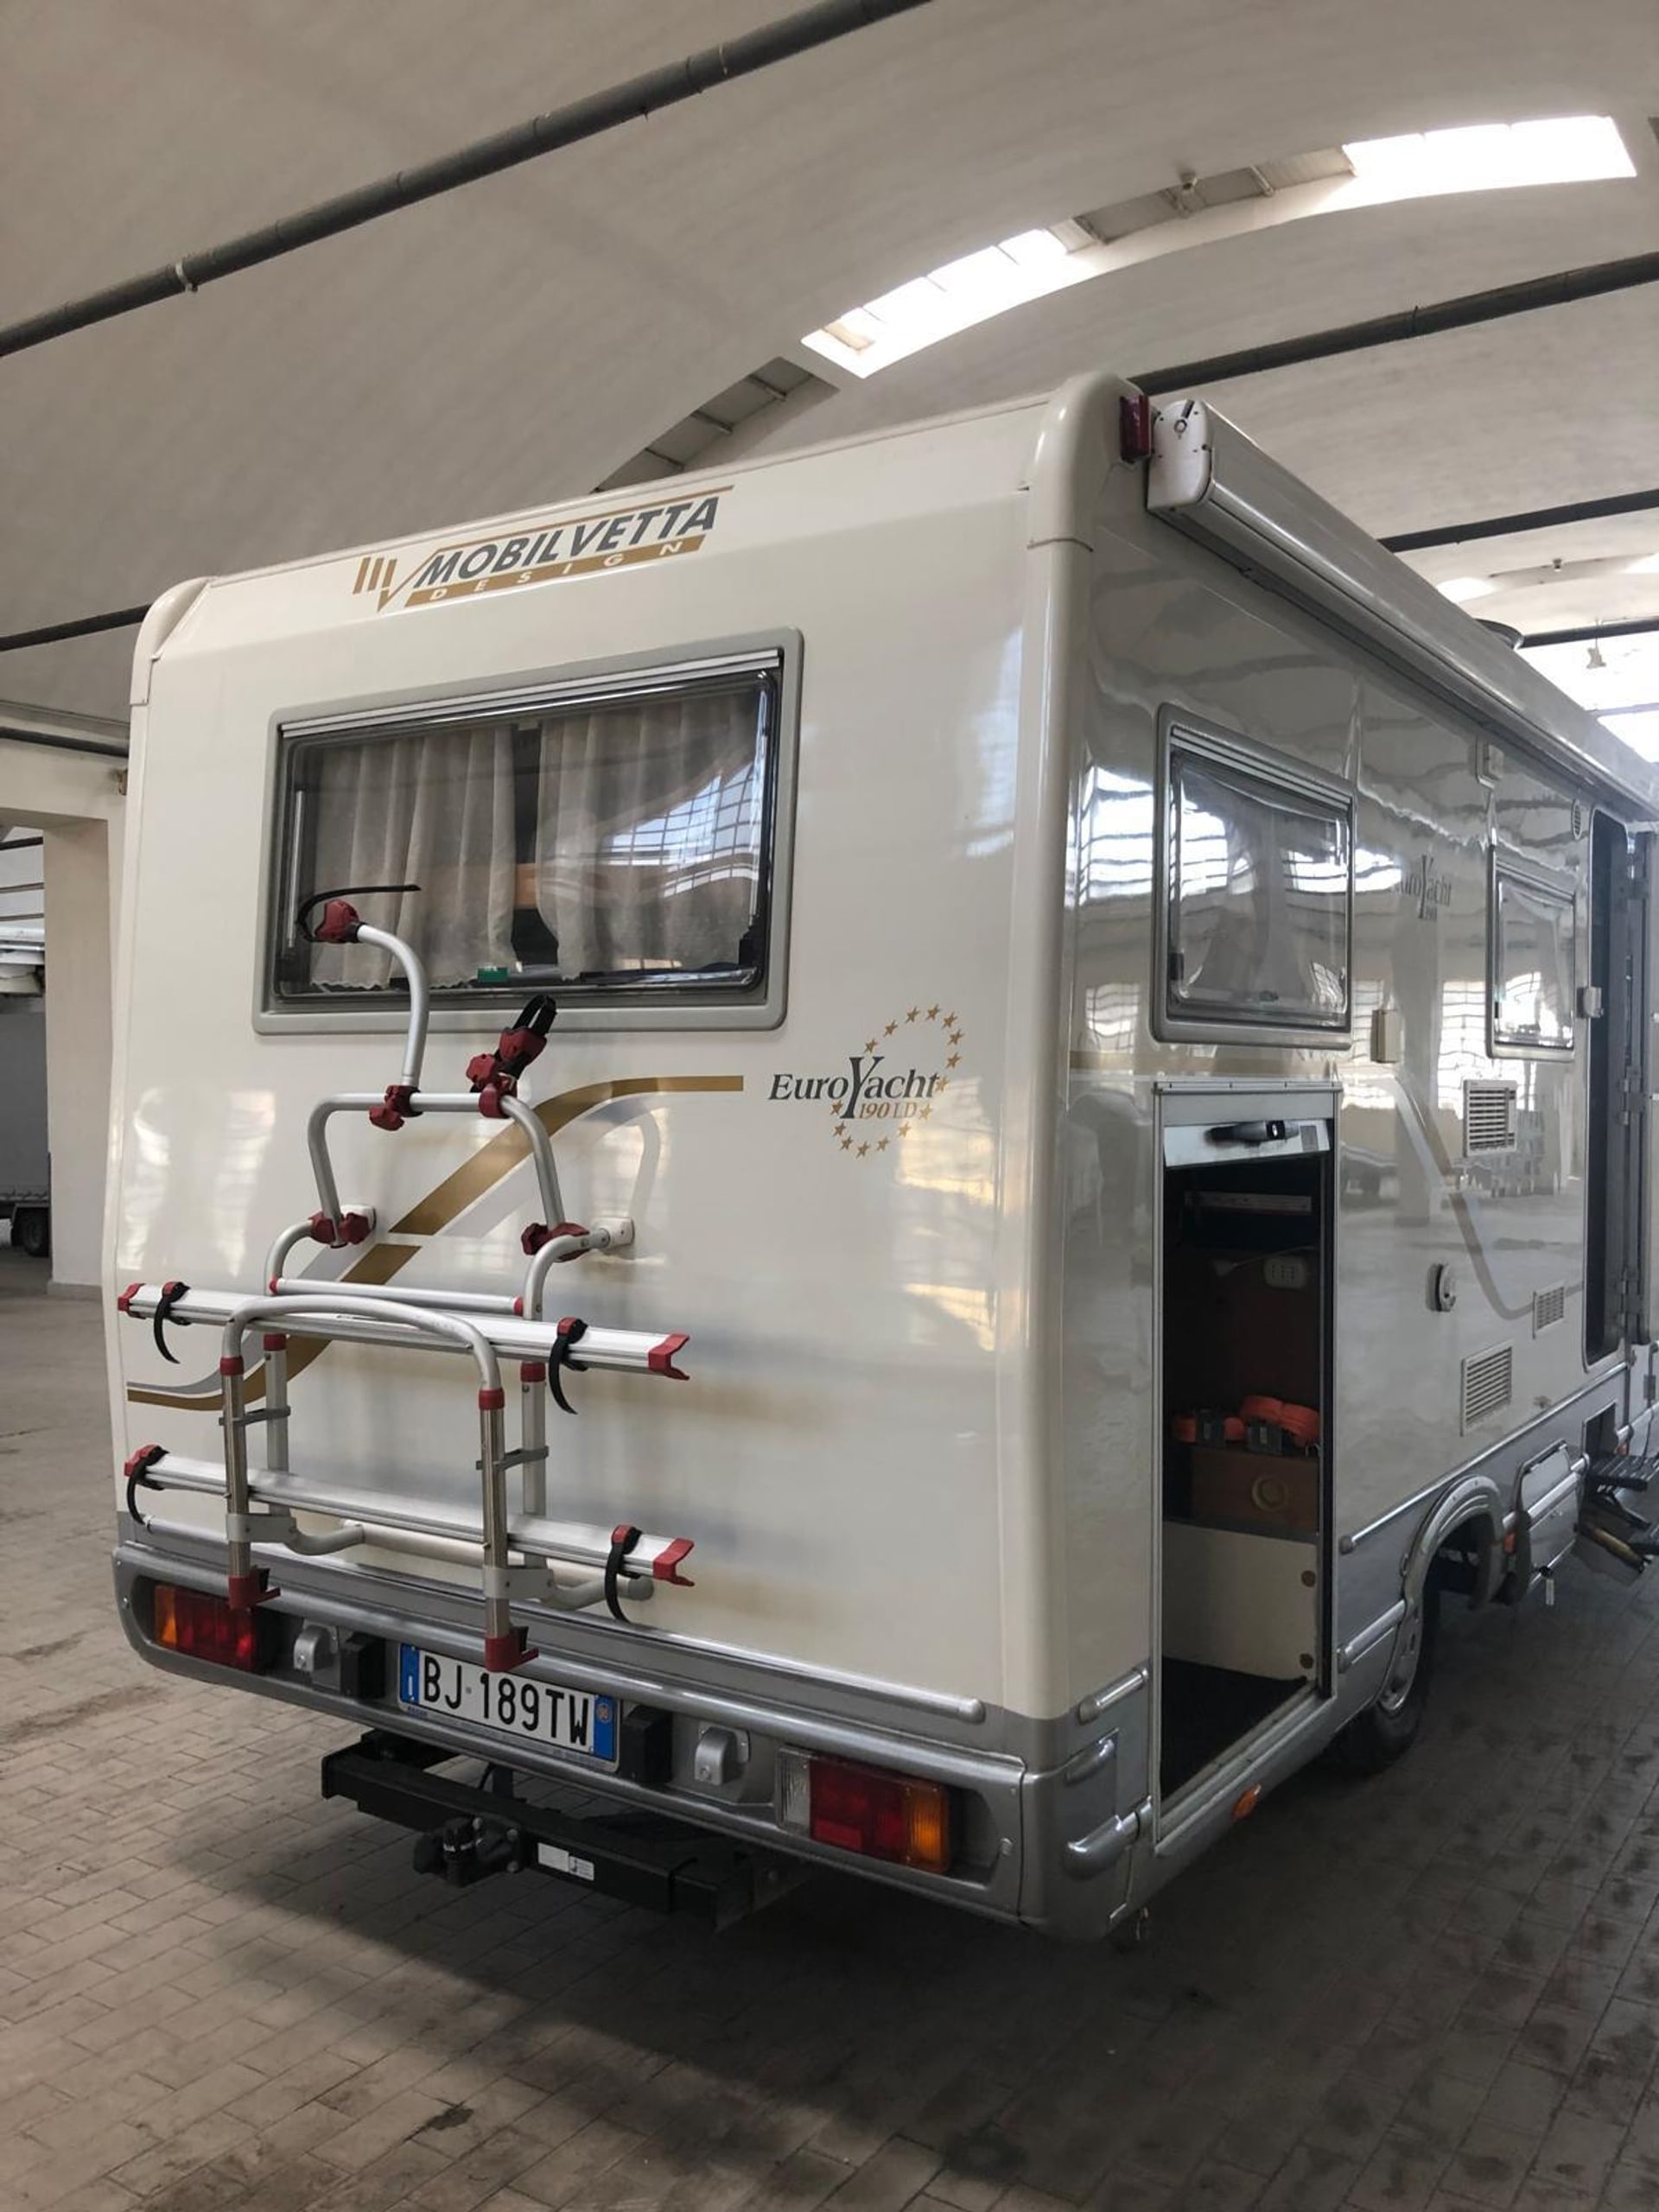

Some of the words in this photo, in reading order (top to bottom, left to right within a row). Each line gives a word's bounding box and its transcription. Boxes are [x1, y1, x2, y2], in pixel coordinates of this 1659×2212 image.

[414, 495, 720, 589] MOBILVETTA
[429, 541, 683, 601] DESIGN
[767, 1056, 940, 1119] EuroYacht
